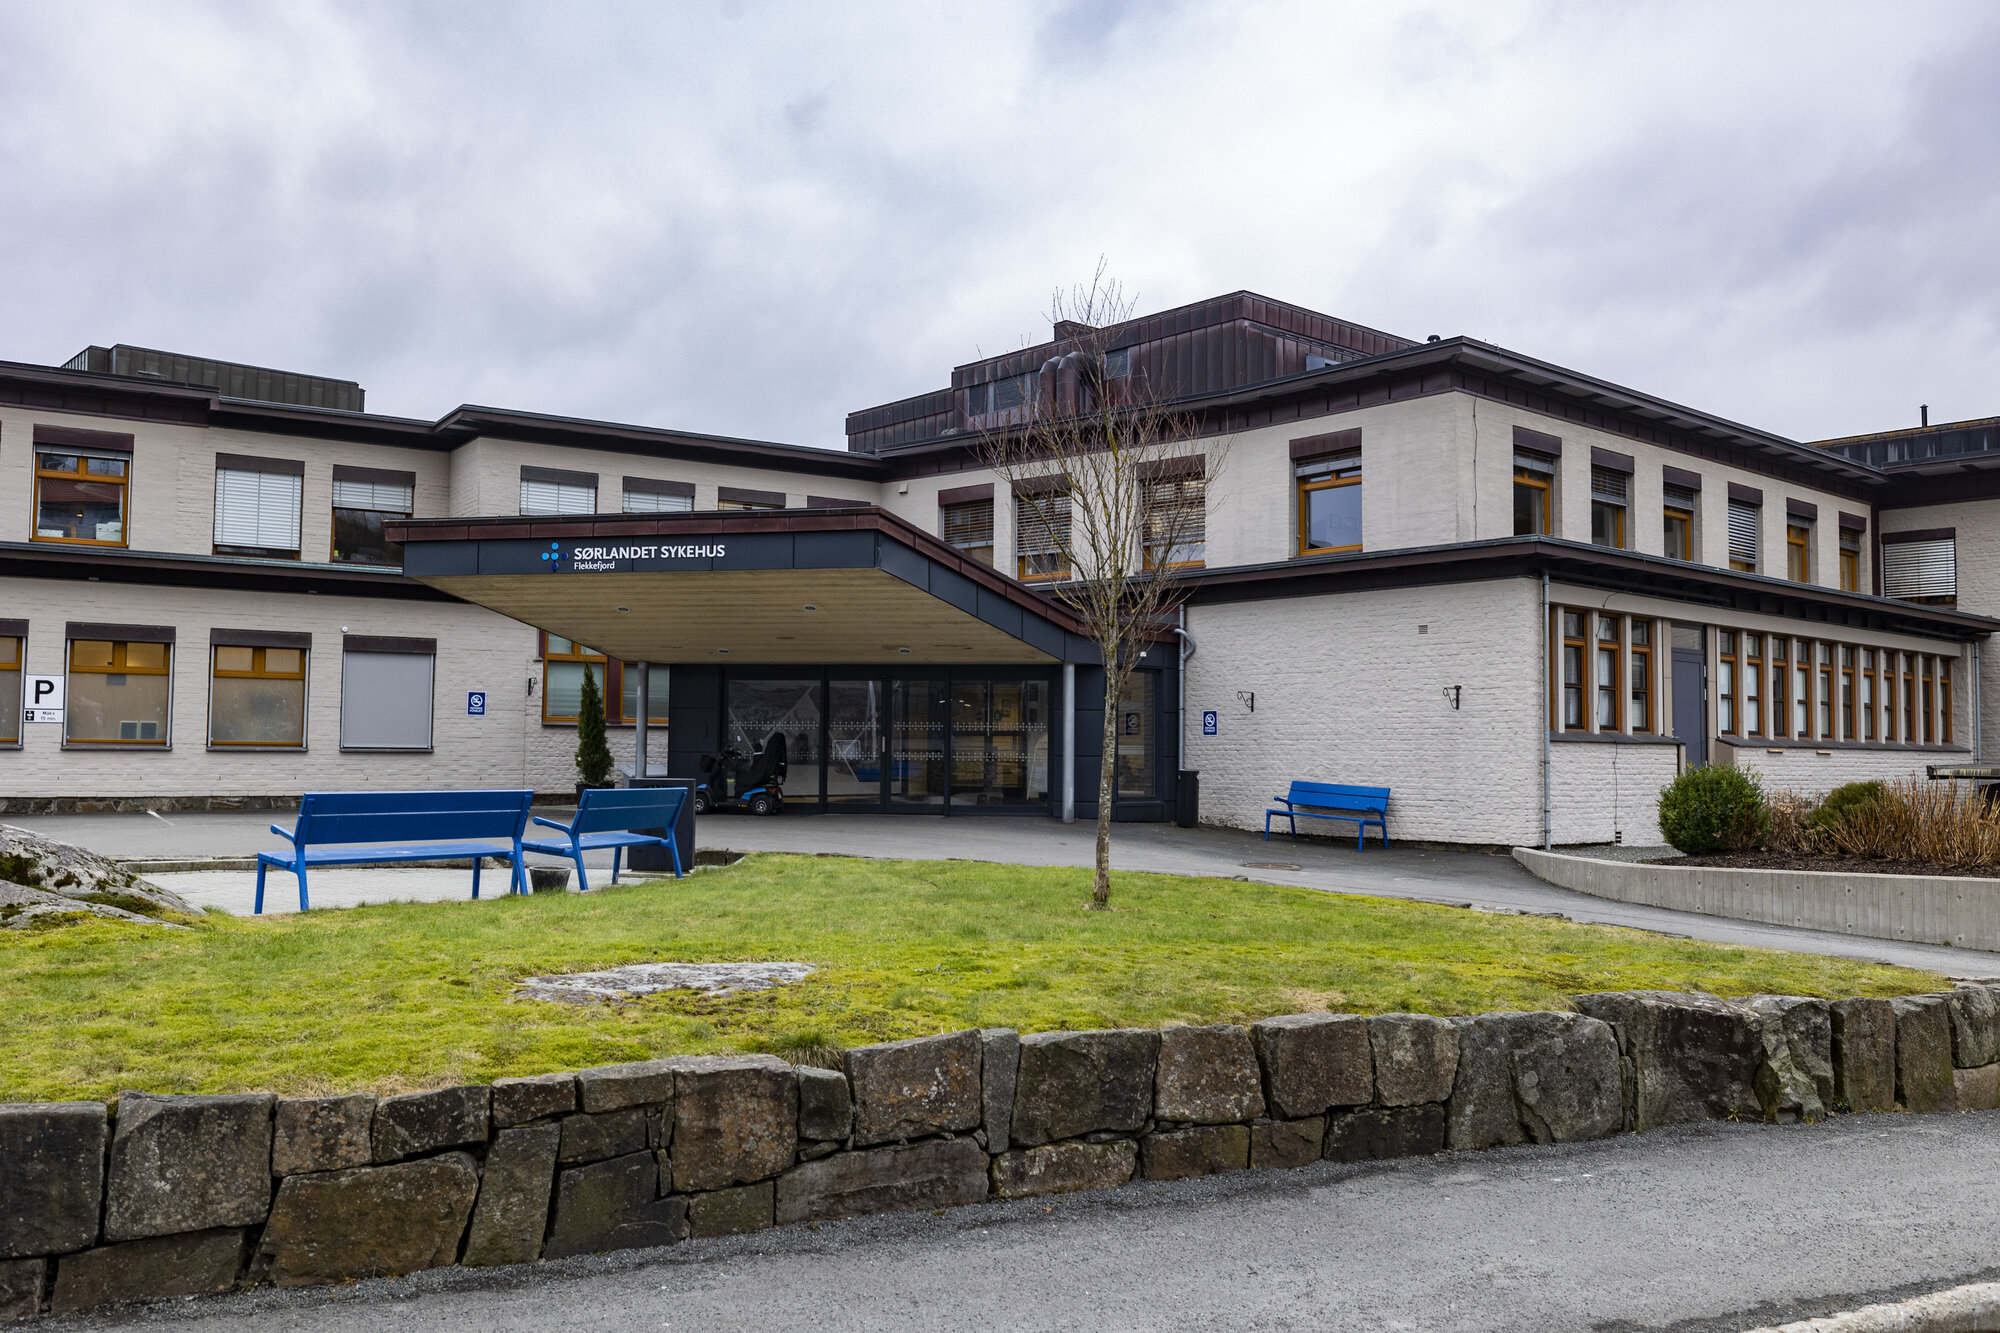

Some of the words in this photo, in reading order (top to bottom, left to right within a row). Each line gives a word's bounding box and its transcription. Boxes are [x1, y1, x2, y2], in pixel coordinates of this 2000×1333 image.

[574, 546, 658, 560] SØRLANDET
[660, 545, 726, 559] SYKEHUS
[573, 561, 615, 571] Flekkefjord
[34, 680, 54, 704] P
